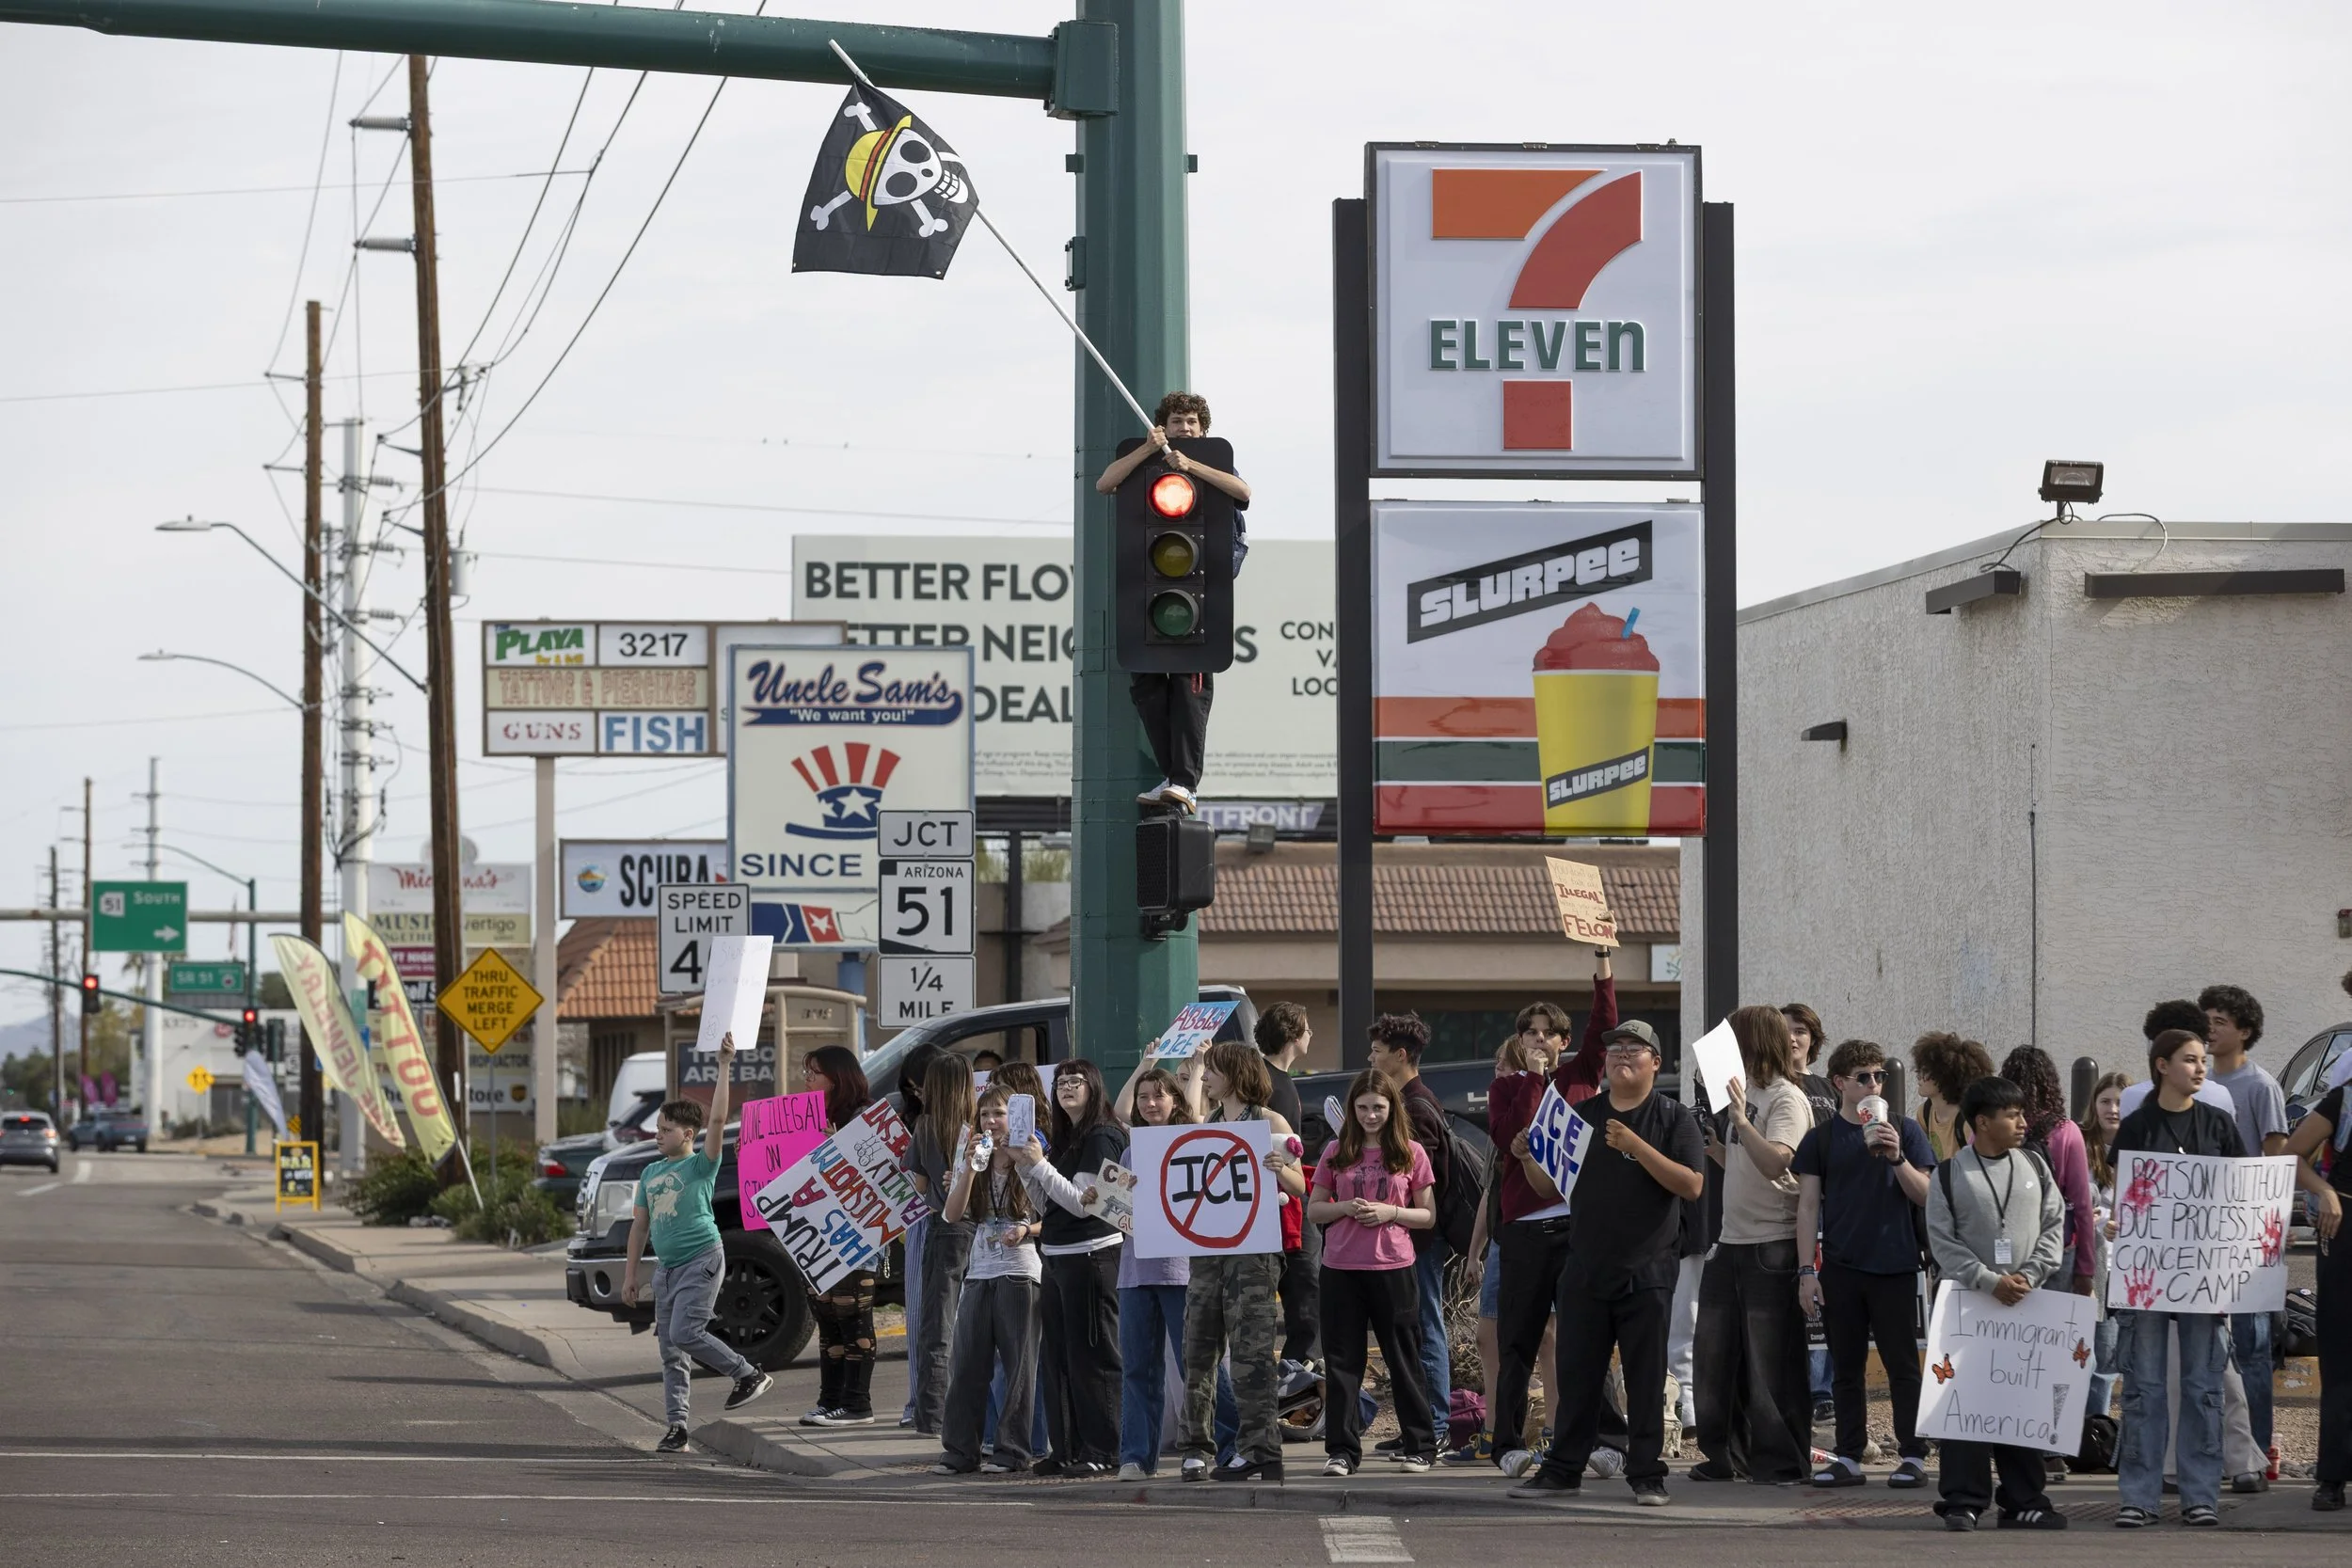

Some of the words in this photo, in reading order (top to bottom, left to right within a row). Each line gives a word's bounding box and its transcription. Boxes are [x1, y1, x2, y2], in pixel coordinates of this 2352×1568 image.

[806, 562, 970, 600] BETTER
[495, 628, 584, 660] PLAYA
[619, 632, 689, 657] 3217
[847, 624, 970, 646] ETTER
[982, 624, 1073, 662] NEI
[1280, 621, 1334, 641] CON
[499, 669, 575, 705] TATTOOS
[600, 669, 697, 705] PIERCINGS
[747, 659, 850, 705] Uncle
[853, 660, 950, 705] Sam's
[1292, 676, 1337, 696] LOC
[828, 710, 866, 721] want
[974, 686, 1073, 723] DEAL
[503, 722, 581, 740] GUNS
[605, 716, 705, 753] FISH
[893, 820, 959, 847] JCT
[1198, 806, 1314, 827] TFRONT
[619, 854, 710, 908] SCUBA
[740, 853, 862, 877] SINCE
[904, 866, 964, 878] ARIZONA
[103, 897, 121, 911] 51
[667, 893, 741, 909] SPEED
[897, 886, 953, 936] 51
[373, 913, 434, 929] MUSI
[675, 915, 734, 932] LIMIT
[1563, 913, 1614, 939] FELON
[473, 970, 509, 982] THRU
[669, 941, 711, 984] 4
[464, 987, 519, 999] TRAFFIC
[467, 1002, 516, 1014] MERGE
[899, 1001, 954, 1019] MILE
[473, 1018, 508, 1031] LEFT
[767, 1095, 822, 1135] ILLEGAL
[1536, 1088, 1584, 1157] ICE
[765, 1144, 782, 1173] ON
[1528, 1125, 1580, 1196] OUT
[792, 1176, 828, 1208] A
[865, 1158, 930, 1227] FAMILY
[1169, 1152, 1254, 1204] ICE
[2132, 1157, 2217, 1200] PRISON
[2224, 1163, 2296, 1203] WITHOUT
[819, 1158, 907, 1247] MUGSHOT
[820, 1209, 874, 1268] HAS
[2119, 1202, 2163, 1240] DUE
[2171, 1202, 2248, 1242] PROCESS
[2248, 1206, 2266, 1242] IS
[756, 1194, 842, 1293] TRUMP
[2166, 1270, 2251, 1306] CAMP
[1949, 1289, 2079, 1353] Immigrants
[1990, 1349, 2046, 1389] built
[1943, 1384, 2071, 1445] America!
